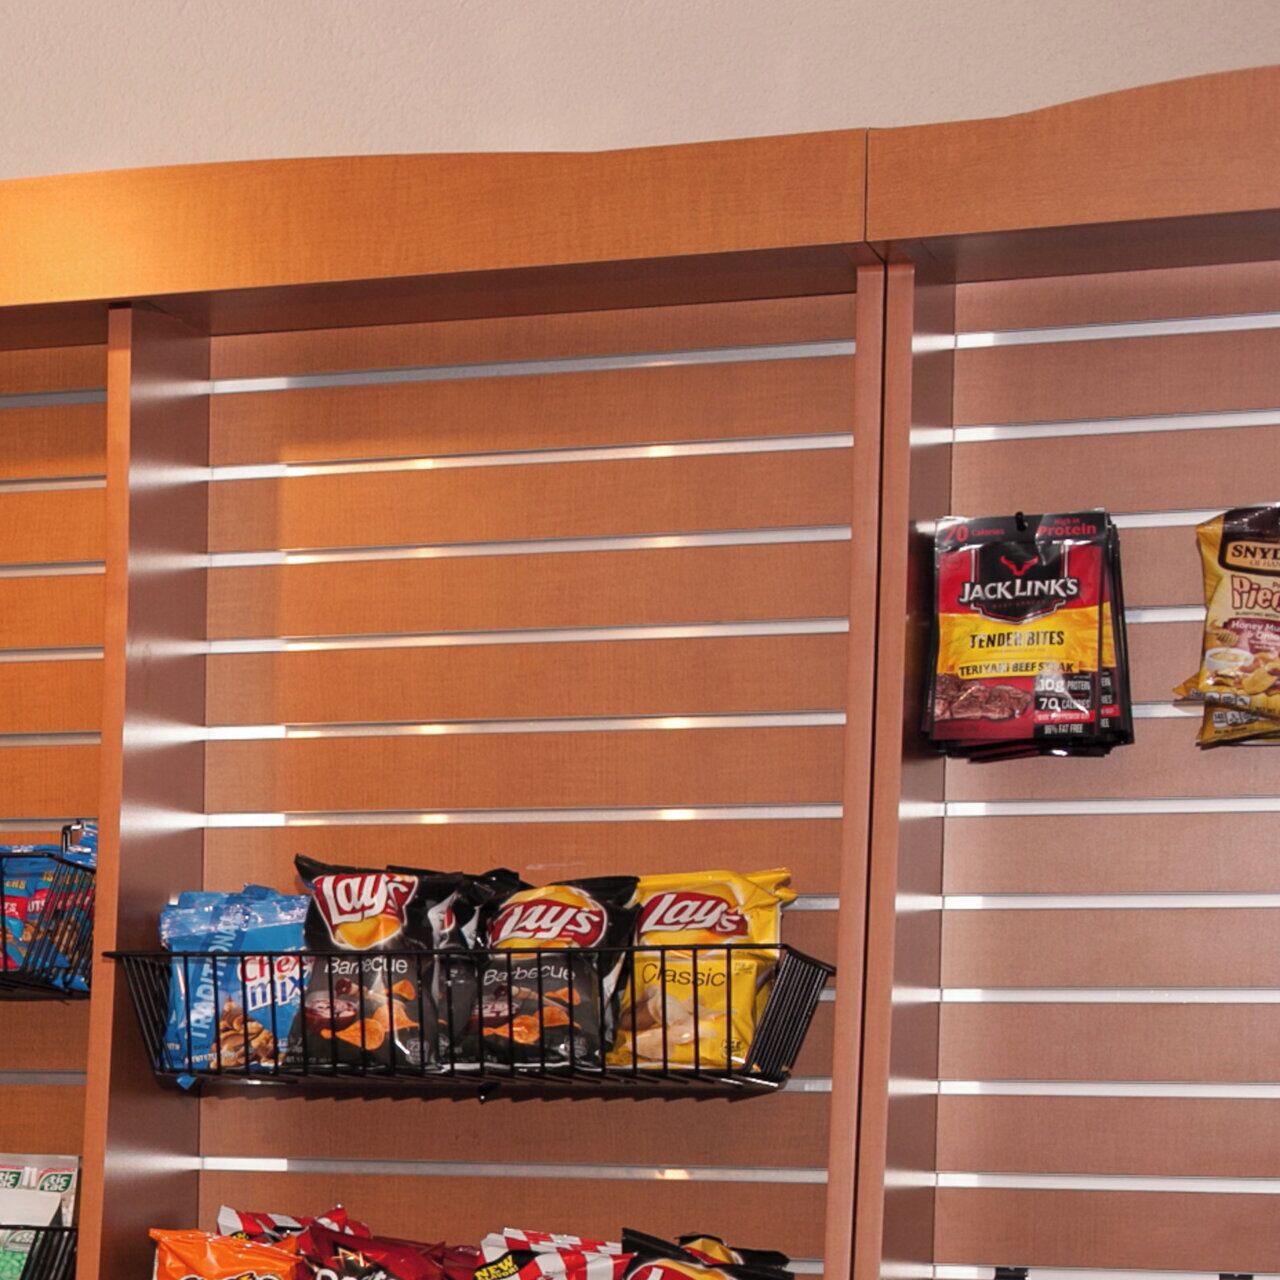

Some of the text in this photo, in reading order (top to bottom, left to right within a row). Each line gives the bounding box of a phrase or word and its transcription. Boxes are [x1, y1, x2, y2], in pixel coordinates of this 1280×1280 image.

[1038, 524, 1097, 537] Protein
[959, 578, 1078, 603] JACK LINK'S
[970, 631, 1065, 649] TENDER BITES
[499, 903, 601, 944] Lay's
[641, 893, 742, 933] Lay's
[642, 963, 727, 987] Classic
[0, 1171, 18, 1182] tic
[44, 1181, 65, 1191] tac
[50, 1174, 68, 1184] tic
[474, 1254, 515, 1280] NEW
